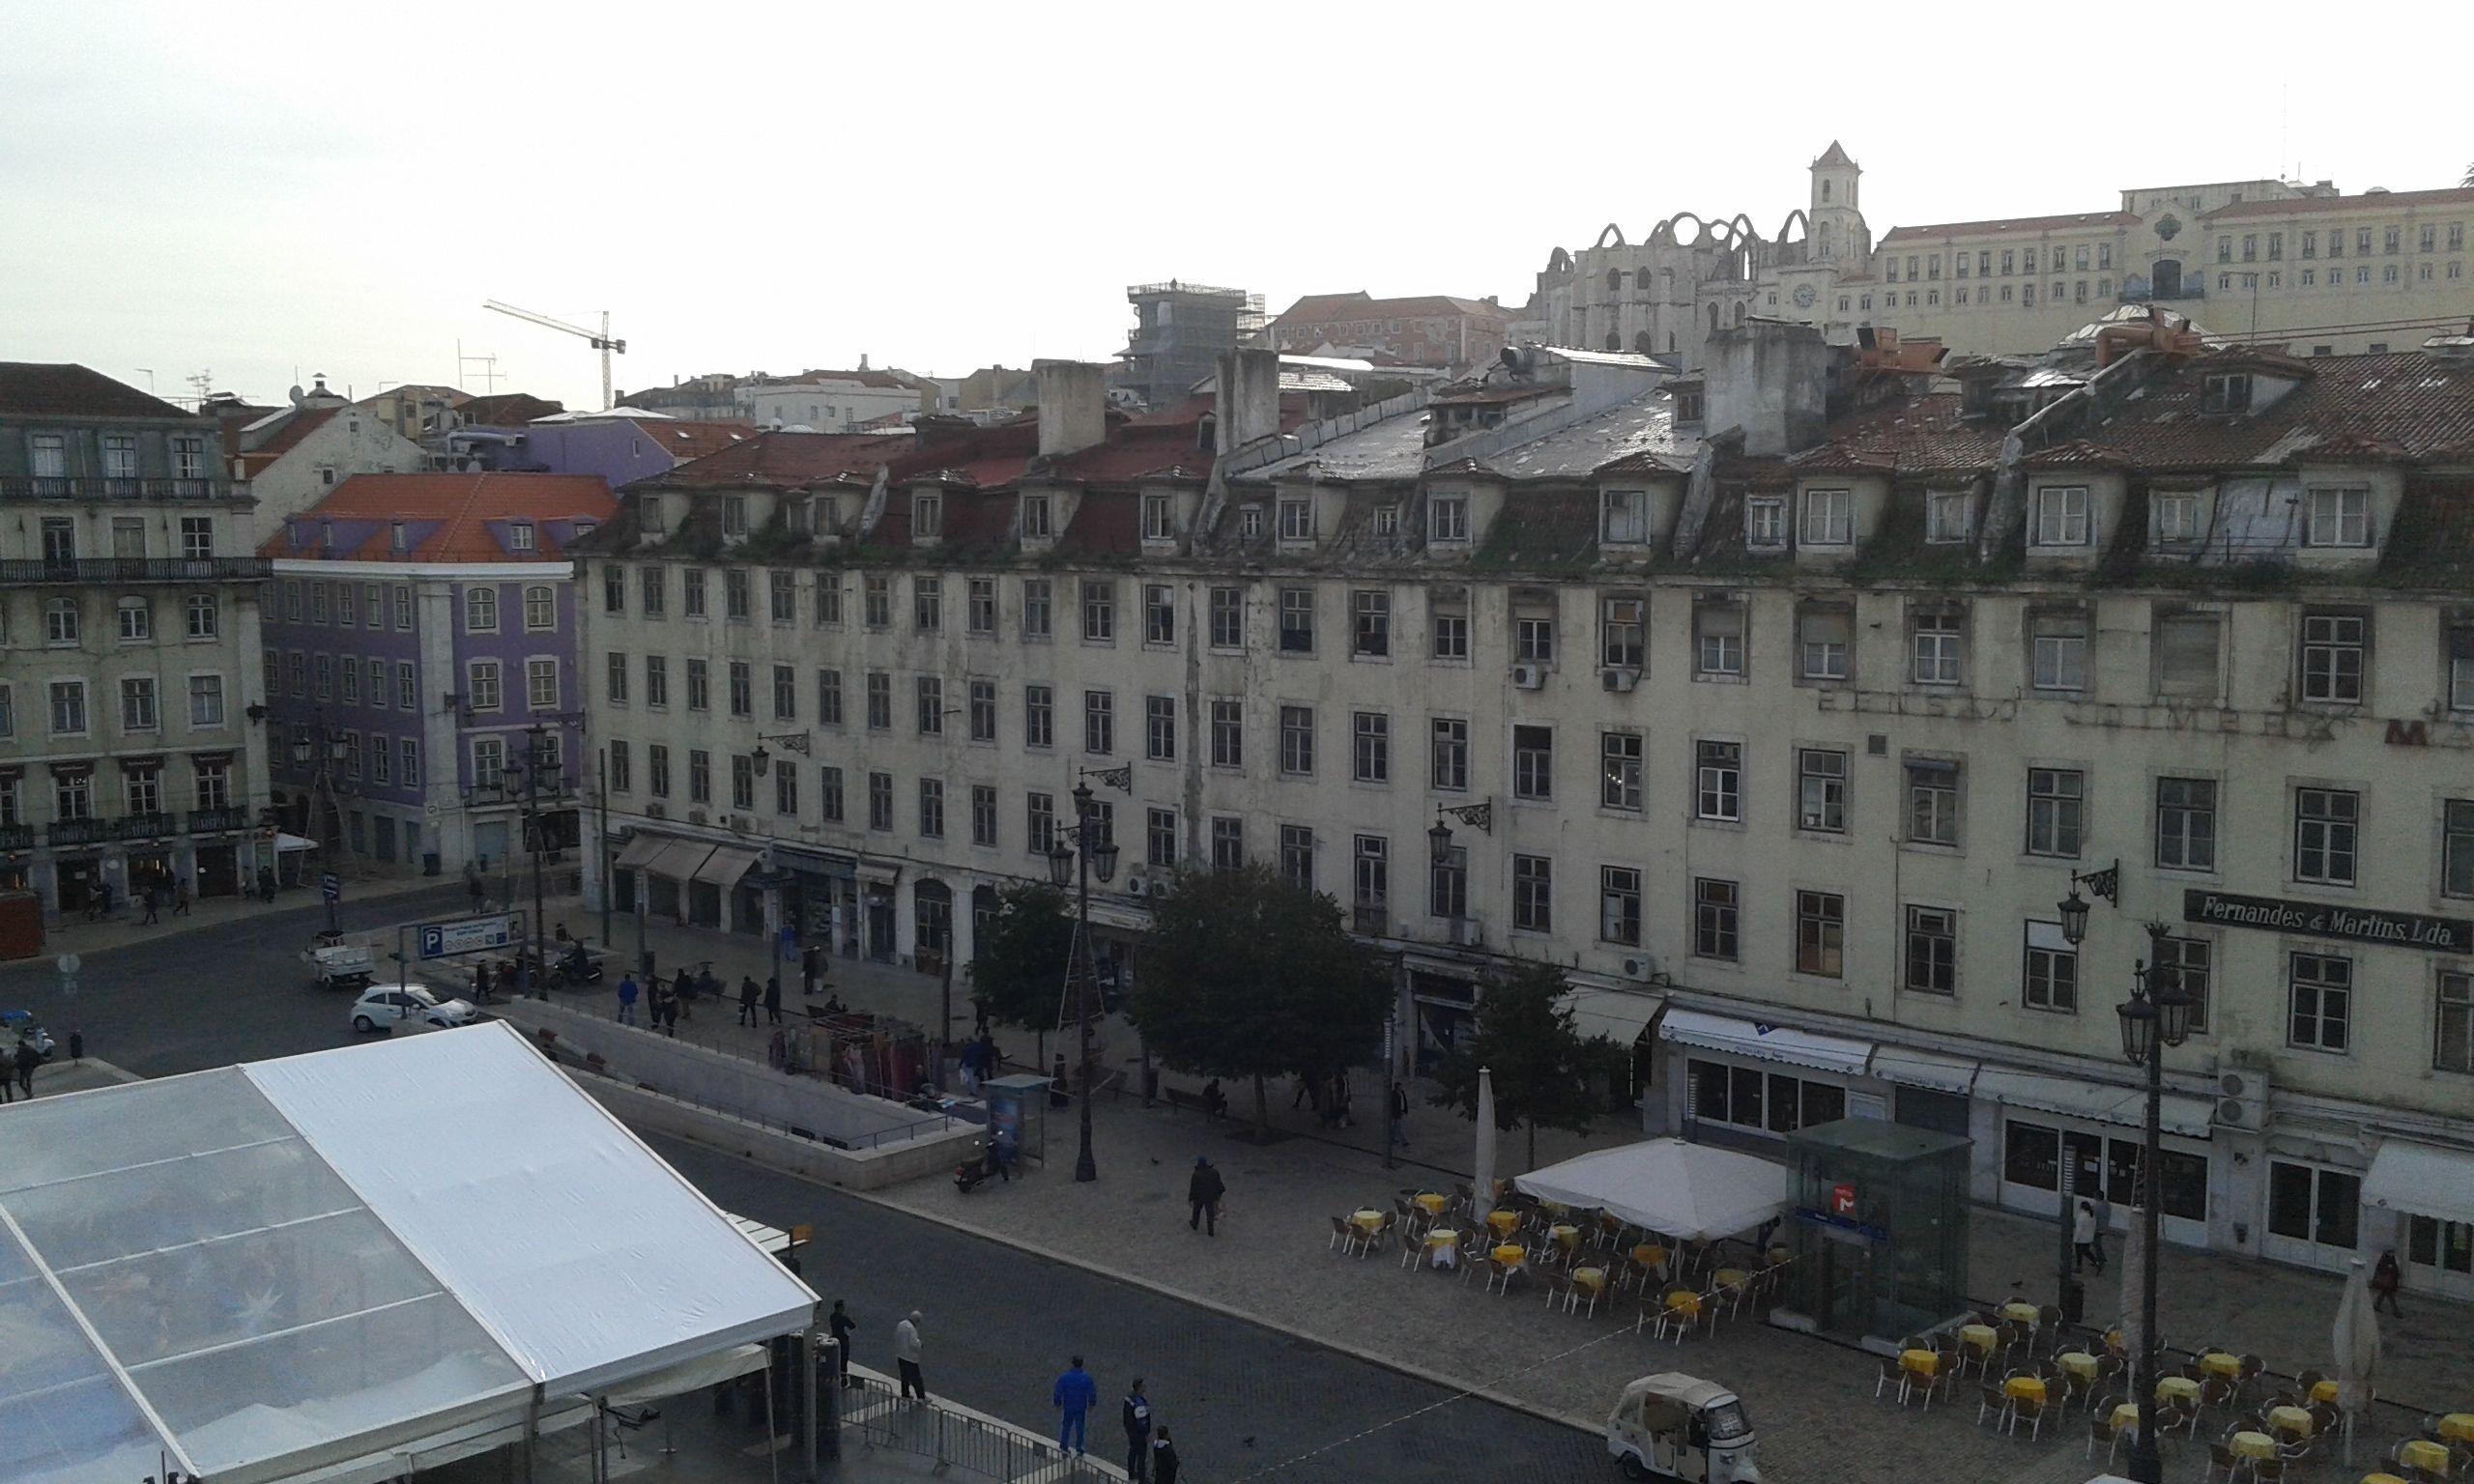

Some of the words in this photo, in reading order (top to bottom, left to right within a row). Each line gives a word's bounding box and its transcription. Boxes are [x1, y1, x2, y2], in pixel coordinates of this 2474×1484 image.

[2201, 895, 2305, 928] Fernandes
[2310, 914, 2323, 930] &
[426, 932, 440, 951] P
